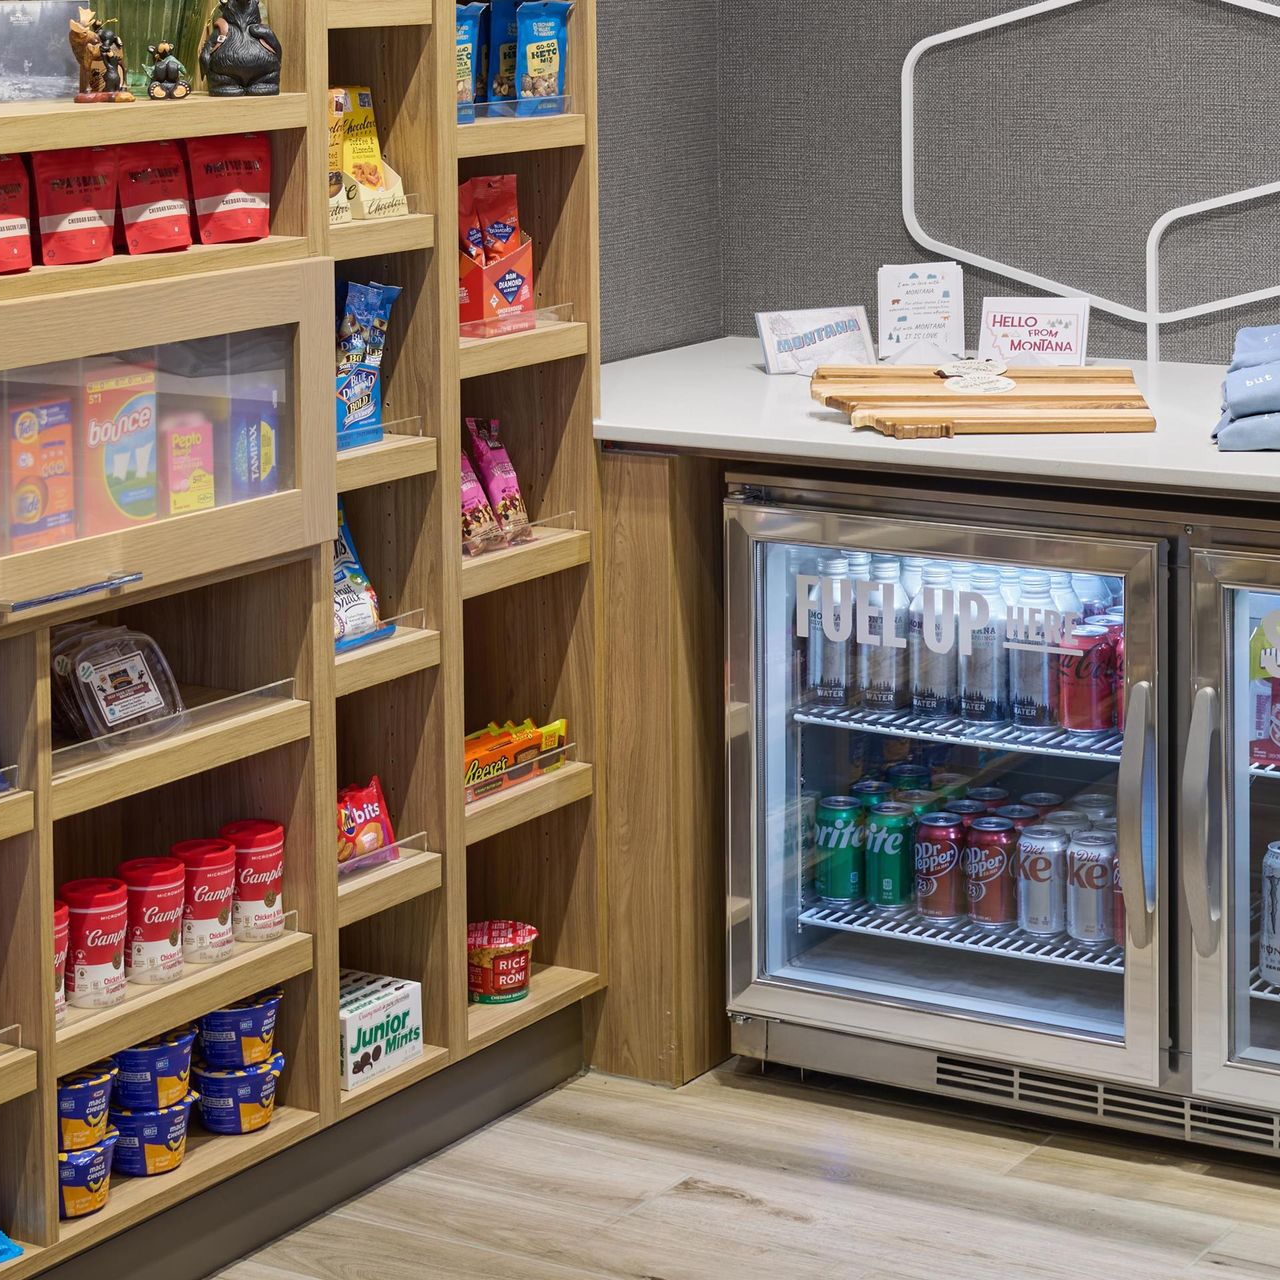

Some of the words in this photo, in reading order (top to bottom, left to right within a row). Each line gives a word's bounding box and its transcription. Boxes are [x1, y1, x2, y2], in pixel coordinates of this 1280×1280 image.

[536, 41, 556, 50] GO-GO
[531, 48, 558, 60] KETO
[540, 56, 554, 64] MIX
[498, 278, 523, 289] DIAMOND
[905, 287, 935, 296] MONTANA
[914, 322, 946, 331] MONTANA
[992, 314, 1038, 329] HELLO
[775, 317, 862, 354] MONTANA
[1028, 328, 1058, 339] FROM
[1009, 338, 1073, 354] MONTANA
[350, 370, 368, 388] BLUE
[1244, 373, 1274, 388] but
[349, 395, 371, 413] BOLD
[88, 406, 152, 448] bounce
[249, 424, 259, 481] TAMPAX
[795, 574, 907, 649] FUEL
[922, 586, 990, 657] UP
[1006, 605, 1079, 646] HERE
[353, 801, 381, 824] bits
[922, 841, 942, 858] Dr
[971, 846, 991, 862] Dr
[1022, 841, 1045, 855] Diet
[1076, 849, 1101, 864] Diet
[499, 955, 526, 971] RICE
[499, 972, 526, 986] RONI
[490, 993, 511, 1002] CHEDDAR
[349, 1000, 375, 1015] Junior
[349, 1008, 411, 1056] Junior
[383, 1024, 421, 1056] Mints
